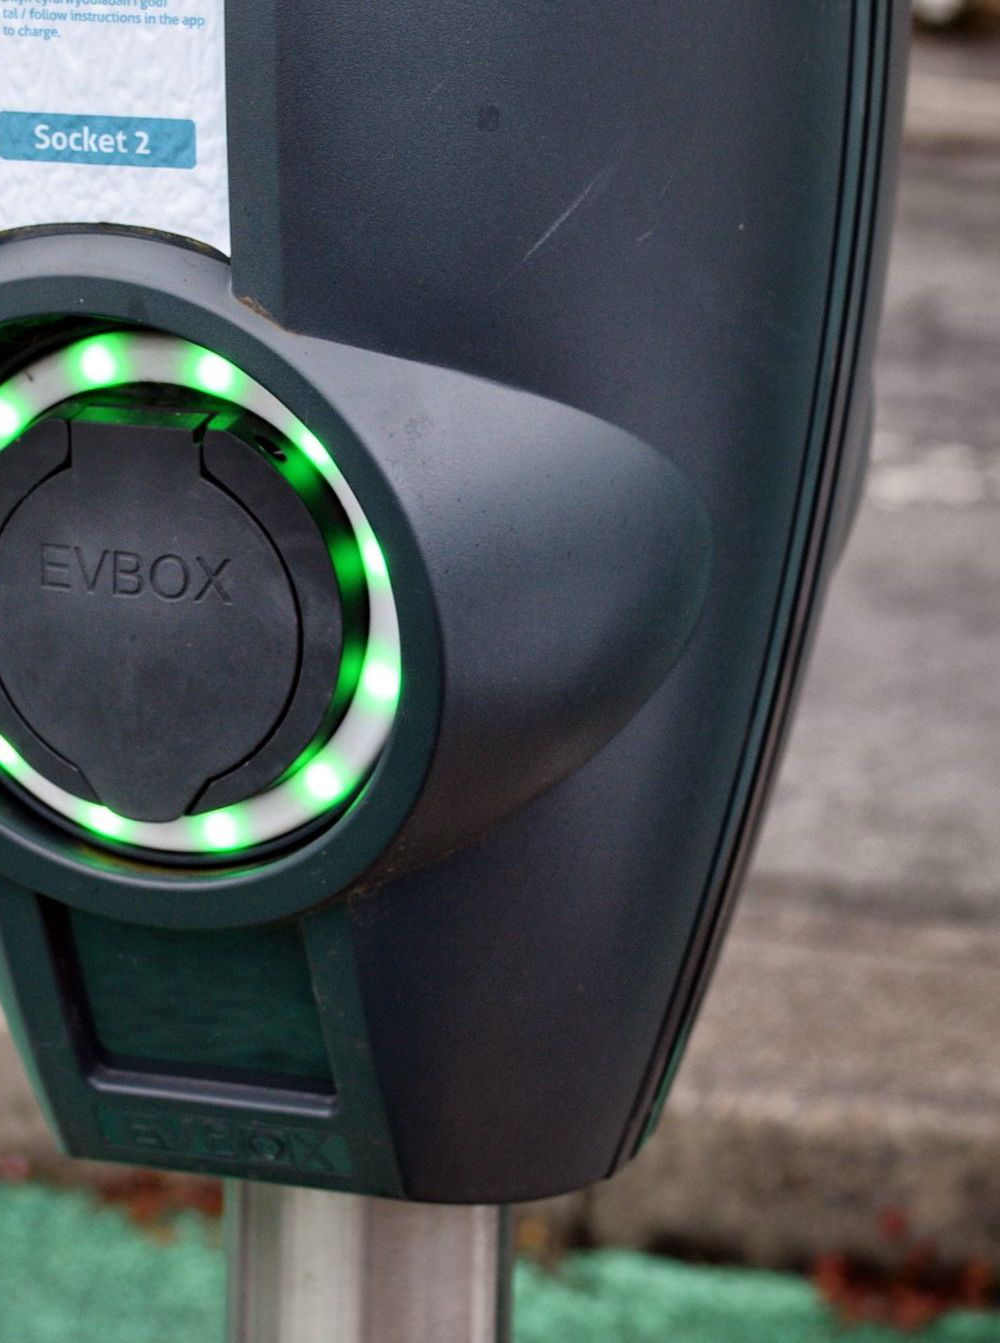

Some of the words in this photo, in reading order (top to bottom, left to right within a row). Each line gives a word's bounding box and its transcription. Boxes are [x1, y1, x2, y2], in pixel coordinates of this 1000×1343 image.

[2, 8, 18, 19] tal
[21, 8, 27, 19] /
[30, 8, 68, 21] follow
[71, 10, 142, 24] instructions
[144, 13, 156, 24] in
[159, 13, 179, 25] the
[182, 16, 205, 29] app
[3, 26, 15, 36] to
[17, 25, 61, 41] charge.
[34, 124, 128, 154] Socket
[134, 131, 151, 155] 2
[41, 543, 232, 605] EVBOX
